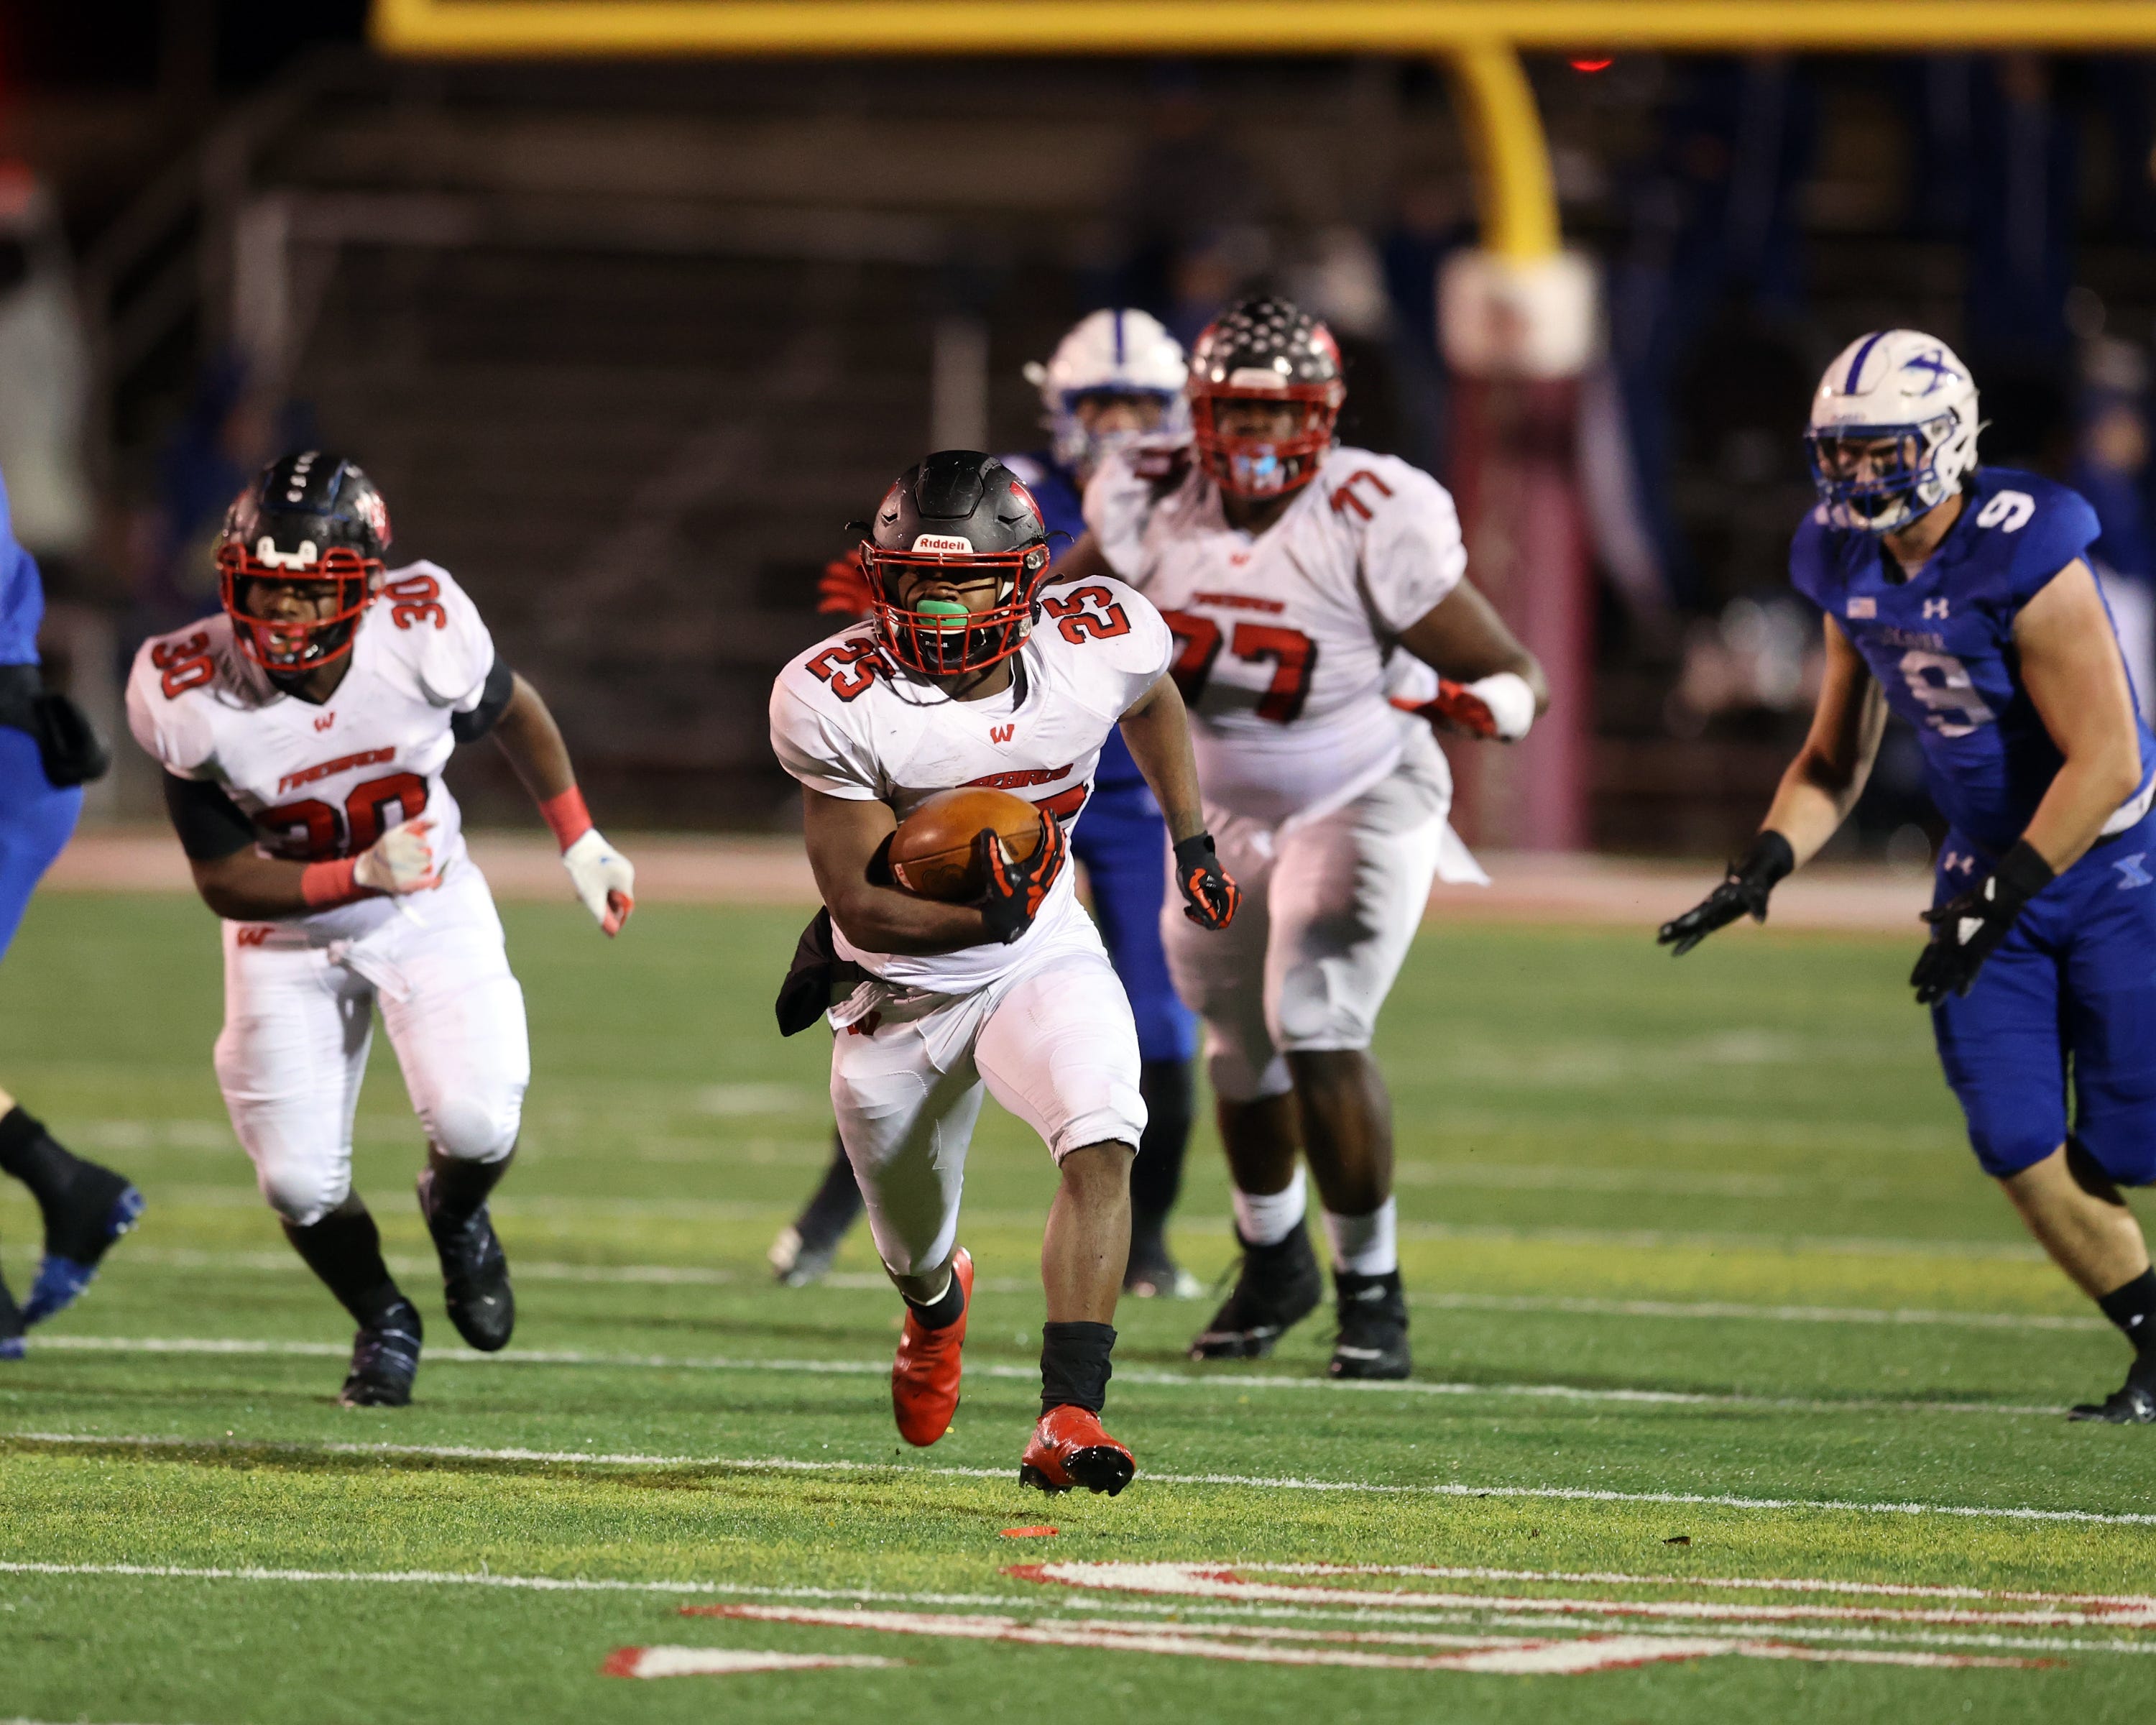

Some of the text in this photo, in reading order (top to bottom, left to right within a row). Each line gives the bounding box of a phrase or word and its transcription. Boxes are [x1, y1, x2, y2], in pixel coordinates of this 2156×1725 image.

[1330, 470, 1394, 521] 77
[1976, 489, 2035, 533] 9
[919, 538, 964, 551] Riddell
[383, 575, 446, 630] 30
[1041, 586, 1132, 645] 25
[152, 632, 215, 700] 30
[805, 638, 896, 702] 25
[1158, 610, 1318, 724] 77
[990, 724, 1015, 745] W
[956, 763, 1074, 789] REBIRDS
